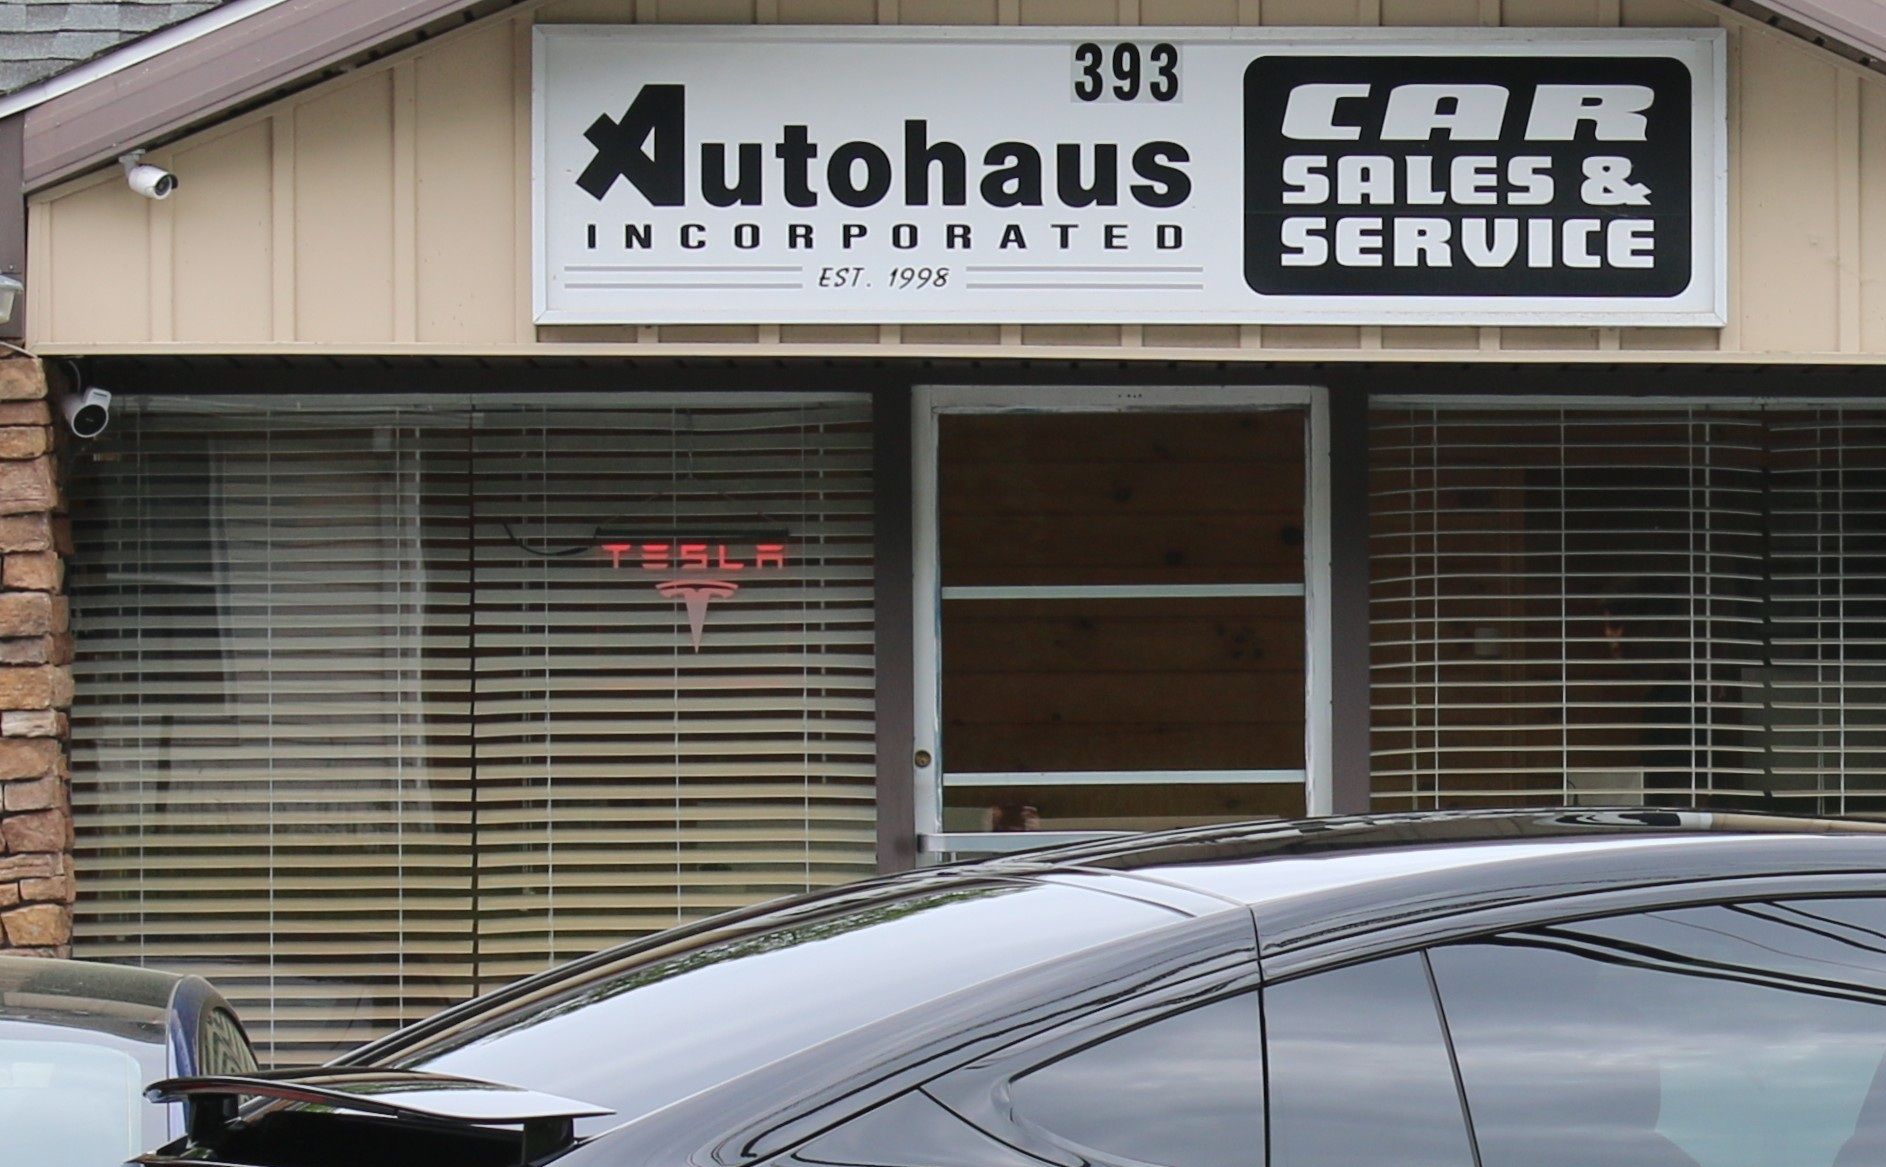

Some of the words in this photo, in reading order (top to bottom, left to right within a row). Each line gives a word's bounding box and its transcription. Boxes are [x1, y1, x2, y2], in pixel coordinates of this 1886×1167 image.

[1074, 42, 1179, 102] 393
[1281, 83, 1655, 141] CAR
[576, 84, 1192, 209] Autohaus
[1282, 155, 1554, 205] SALES
[1581, 156, 1652, 206] &
[587, 223, 1184, 250] INCORPORATED
[1281, 217, 1655, 269] SERVICE
[818, 267, 874, 289] EST.
[888, 267, 950, 289] 1998
[601, 544, 785, 570] TESLA
